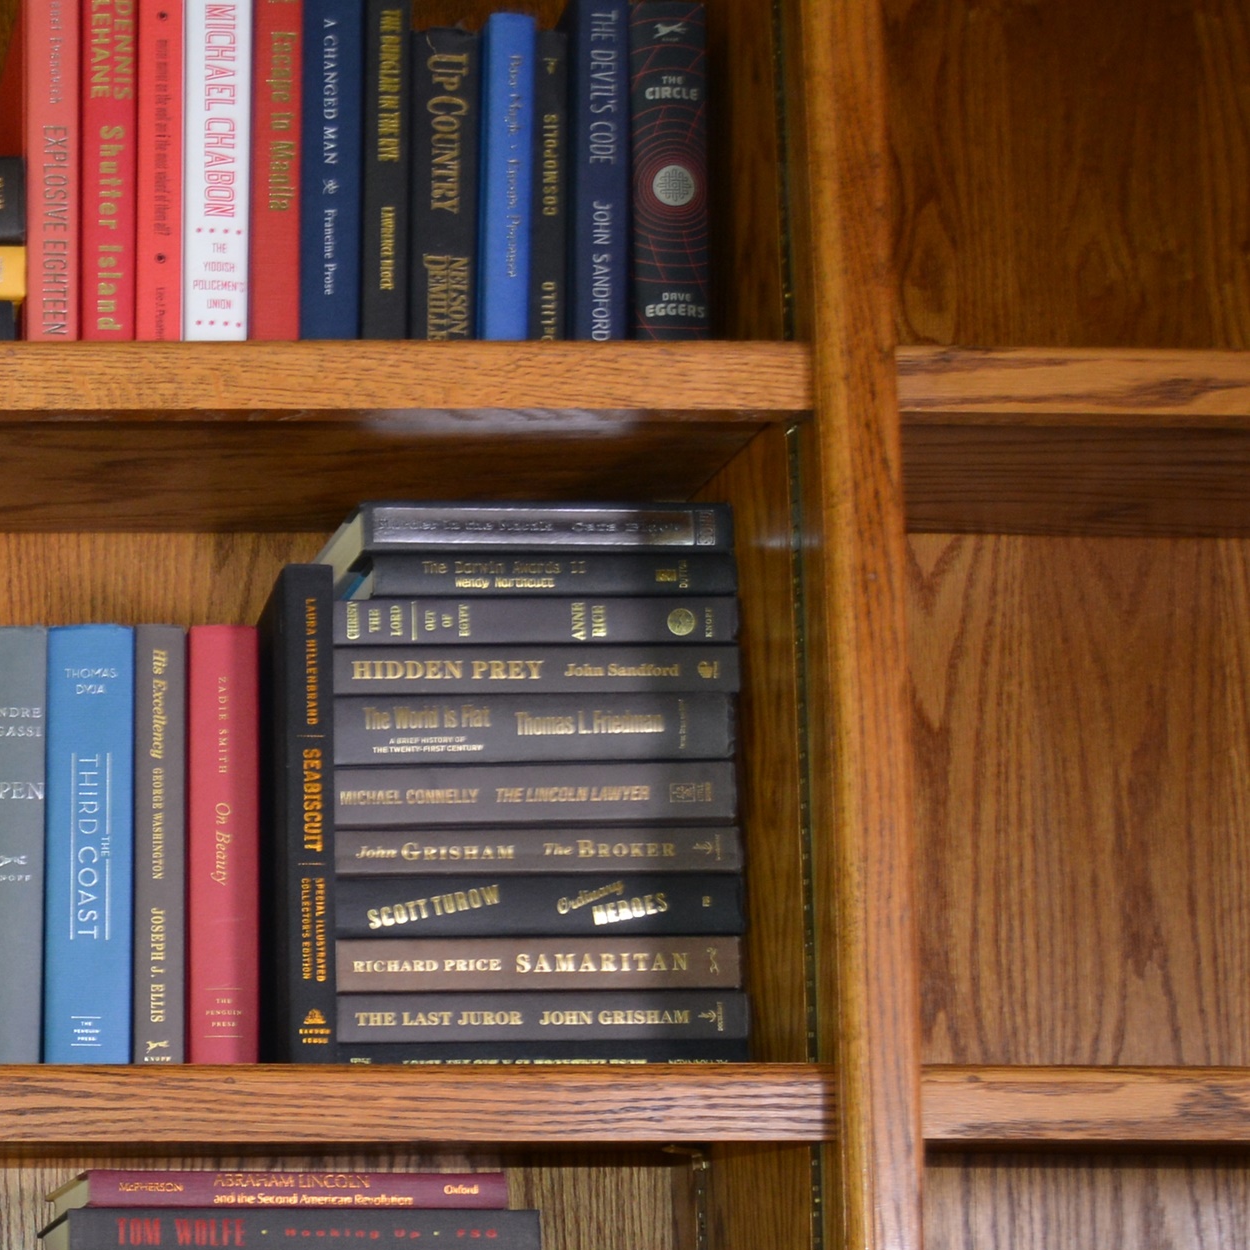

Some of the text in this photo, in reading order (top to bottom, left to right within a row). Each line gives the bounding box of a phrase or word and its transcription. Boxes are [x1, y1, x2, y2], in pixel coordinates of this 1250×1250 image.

[205, 4, 235, 217] MICHAEL CHABON
[323, 35, 339, 119] CHANGED
[589, 10, 617, 164] THE DEVIL'S CODE
[645, 87, 699, 101] CIRCLE
[662, 76, 683, 85] THE
[323, 127, 336, 164] MAN
[43, 126, 68, 335] EXPLOSIVE EIGHTEEN
[98, 126, 124, 330] Shutter Island
[324, 210, 337, 295] Francine Prose
[592, 201, 613, 341] JOHN SANDFORD
[645, 305, 705, 318] EGGERS
[352, 660, 543, 680] HIDDEN PREY
[564, 663, 680, 678] John Sandford
[76, 754, 99, 940] THIRD COAST
[150, 907, 166, 1023] JOSEPH J. ELLIS
[353, 958, 501, 973] RICHARD PRICE
[515, 953, 688, 973] SAMARITAN
